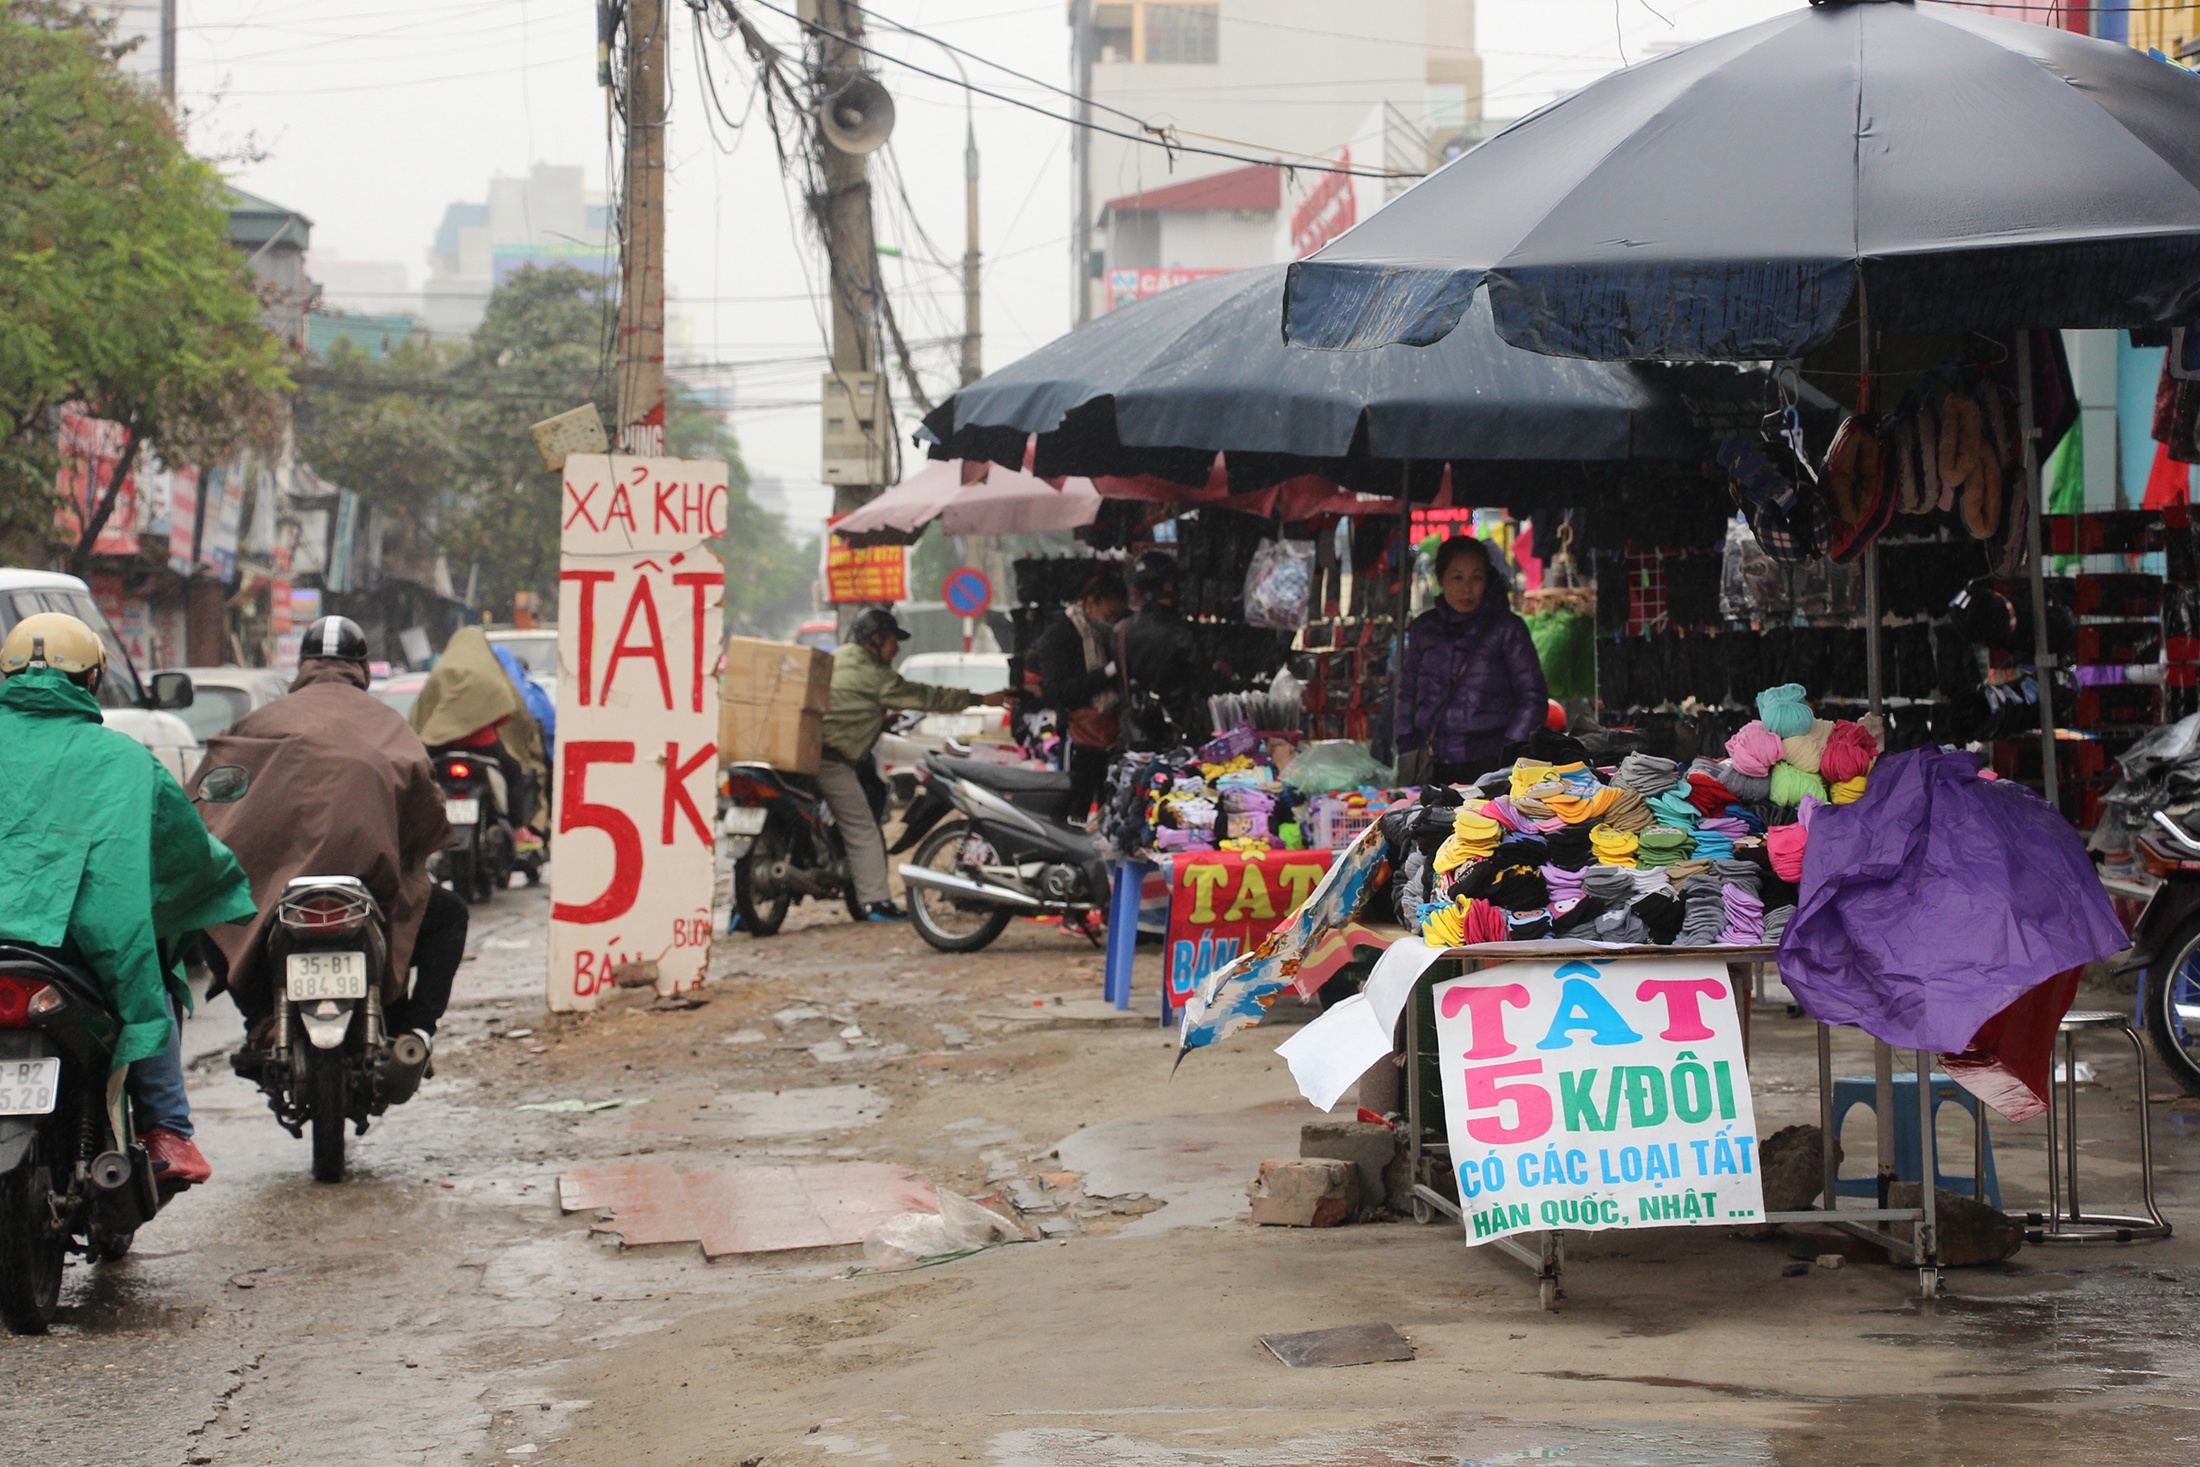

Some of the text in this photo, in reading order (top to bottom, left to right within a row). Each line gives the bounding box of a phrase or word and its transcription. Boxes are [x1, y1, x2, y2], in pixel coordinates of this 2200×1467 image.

[564, 466, 648, 533] XẢ
[560, 551, 725, 714] TẤT
[292, 976, 360, 998] 884.98
[1459, 1124, 1755, 1199] CÓ CÁC LOẠI TẤT
[1472, 1202, 1531, 1239] HÀN
[1541, 1191, 1630, 1227] QUỐC,
[1639, 1187, 1718, 1224] NHẬT
